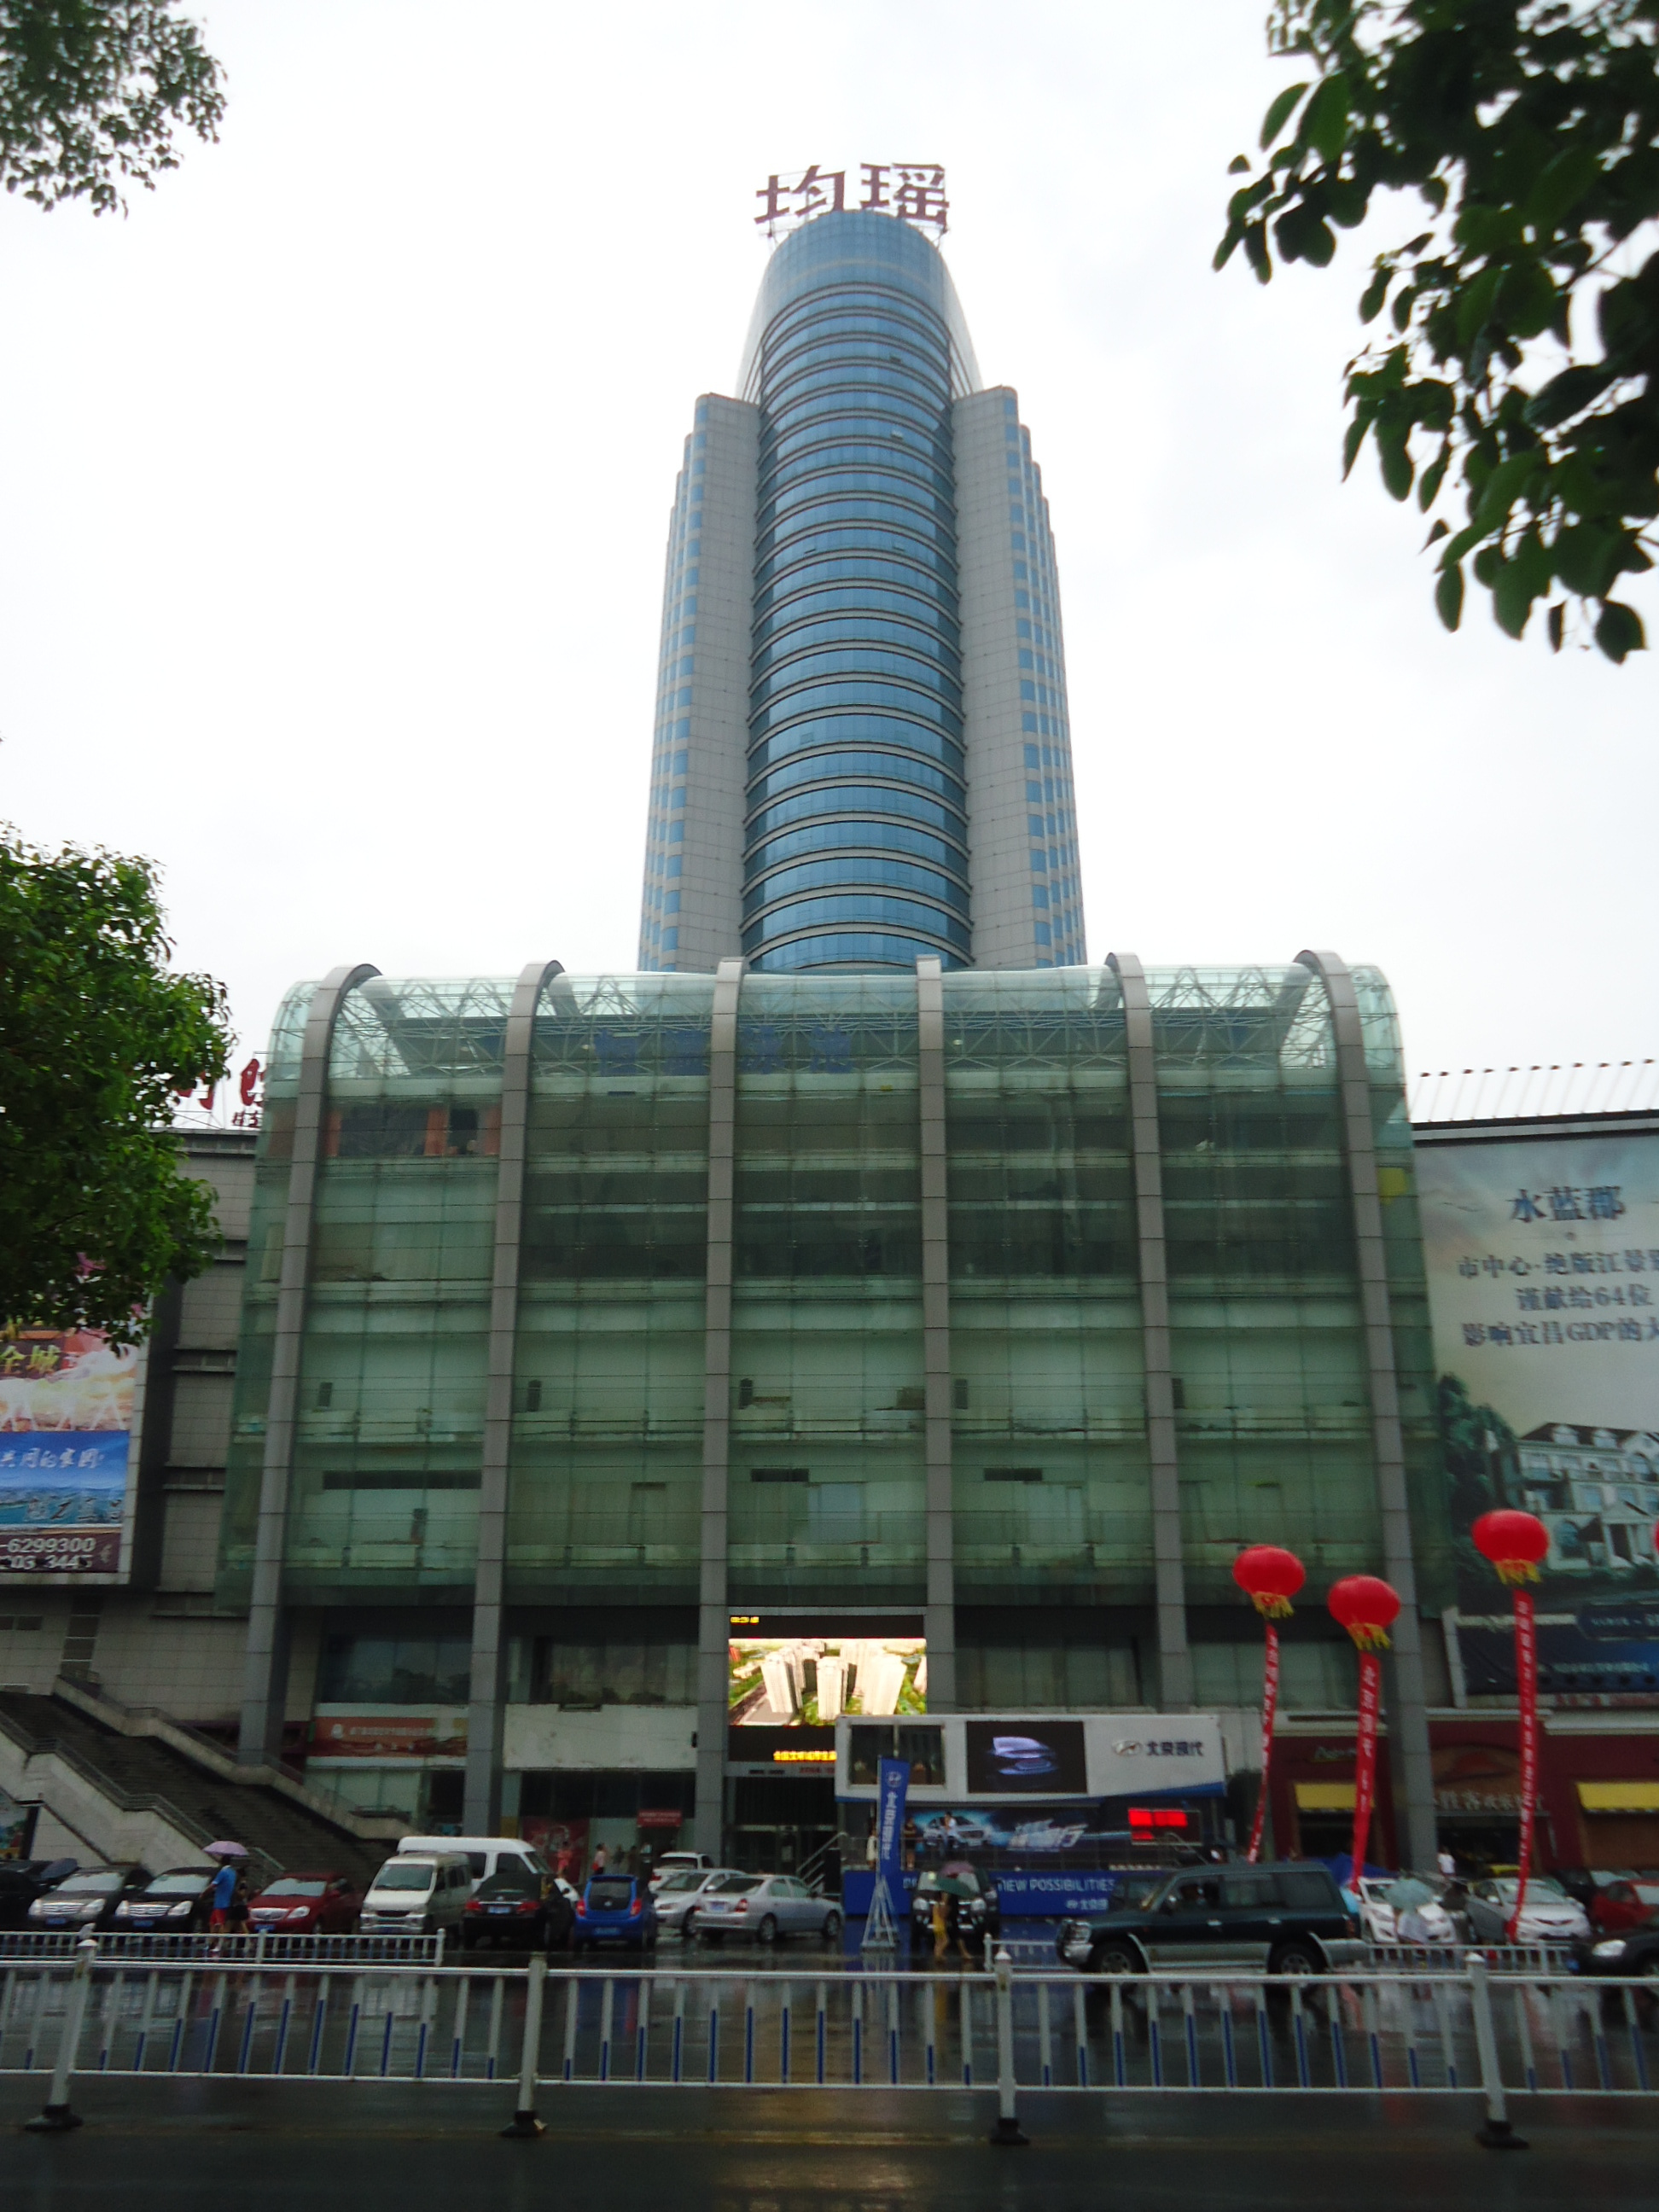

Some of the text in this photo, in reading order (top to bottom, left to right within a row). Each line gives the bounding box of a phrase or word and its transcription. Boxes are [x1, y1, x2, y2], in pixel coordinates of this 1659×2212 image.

[754, 163, 949, 225] 均瑶
[1146, 1741, 1204, 1758] 北京现代
[1029, 1878, 1115, 1892] POSSIBILITIES
